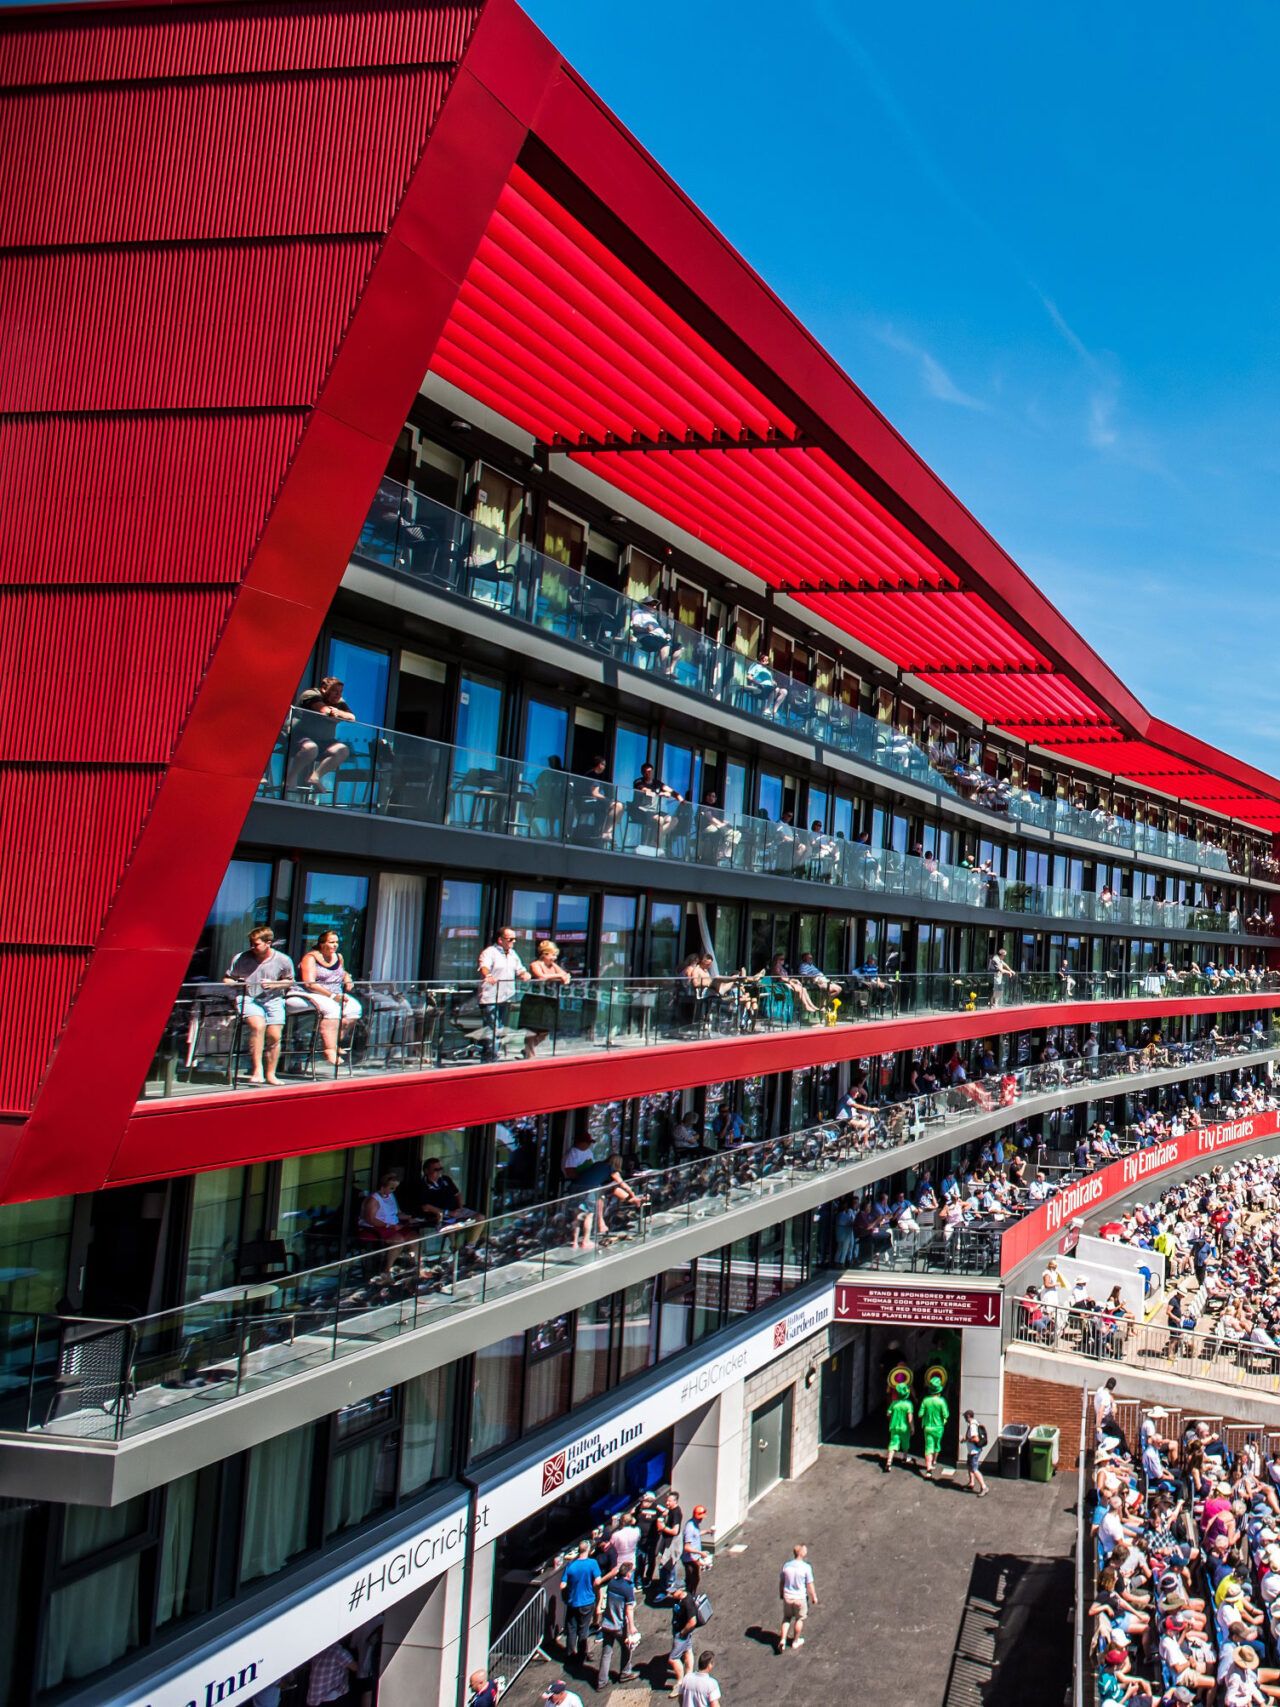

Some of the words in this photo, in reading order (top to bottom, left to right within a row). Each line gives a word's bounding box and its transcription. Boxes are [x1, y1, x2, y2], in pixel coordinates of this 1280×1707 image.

[1198, 1129, 1216, 1151] Fly
[1216, 1119, 1254, 1145] Emirates
[1123, 1157, 1138, 1182] Fly
[1138, 1142, 1179, 1174] Emirates
[1046, 1198, 1062, 1231] Fly
[1062, 1176, 1103, 1218] Emirates
[786, 1316, 815, 1341] Garden
[815, 1307, 828, 1323] Inn
[680, 1349, 748, 1401] #HGICricket
[566, 1438, 618, 1480] Garden
[620, 1422, 643, 1447] Inn
[568, 1433, 600, 1461] Hilton
[348, 1504, 490, 1613] #HGICricket
